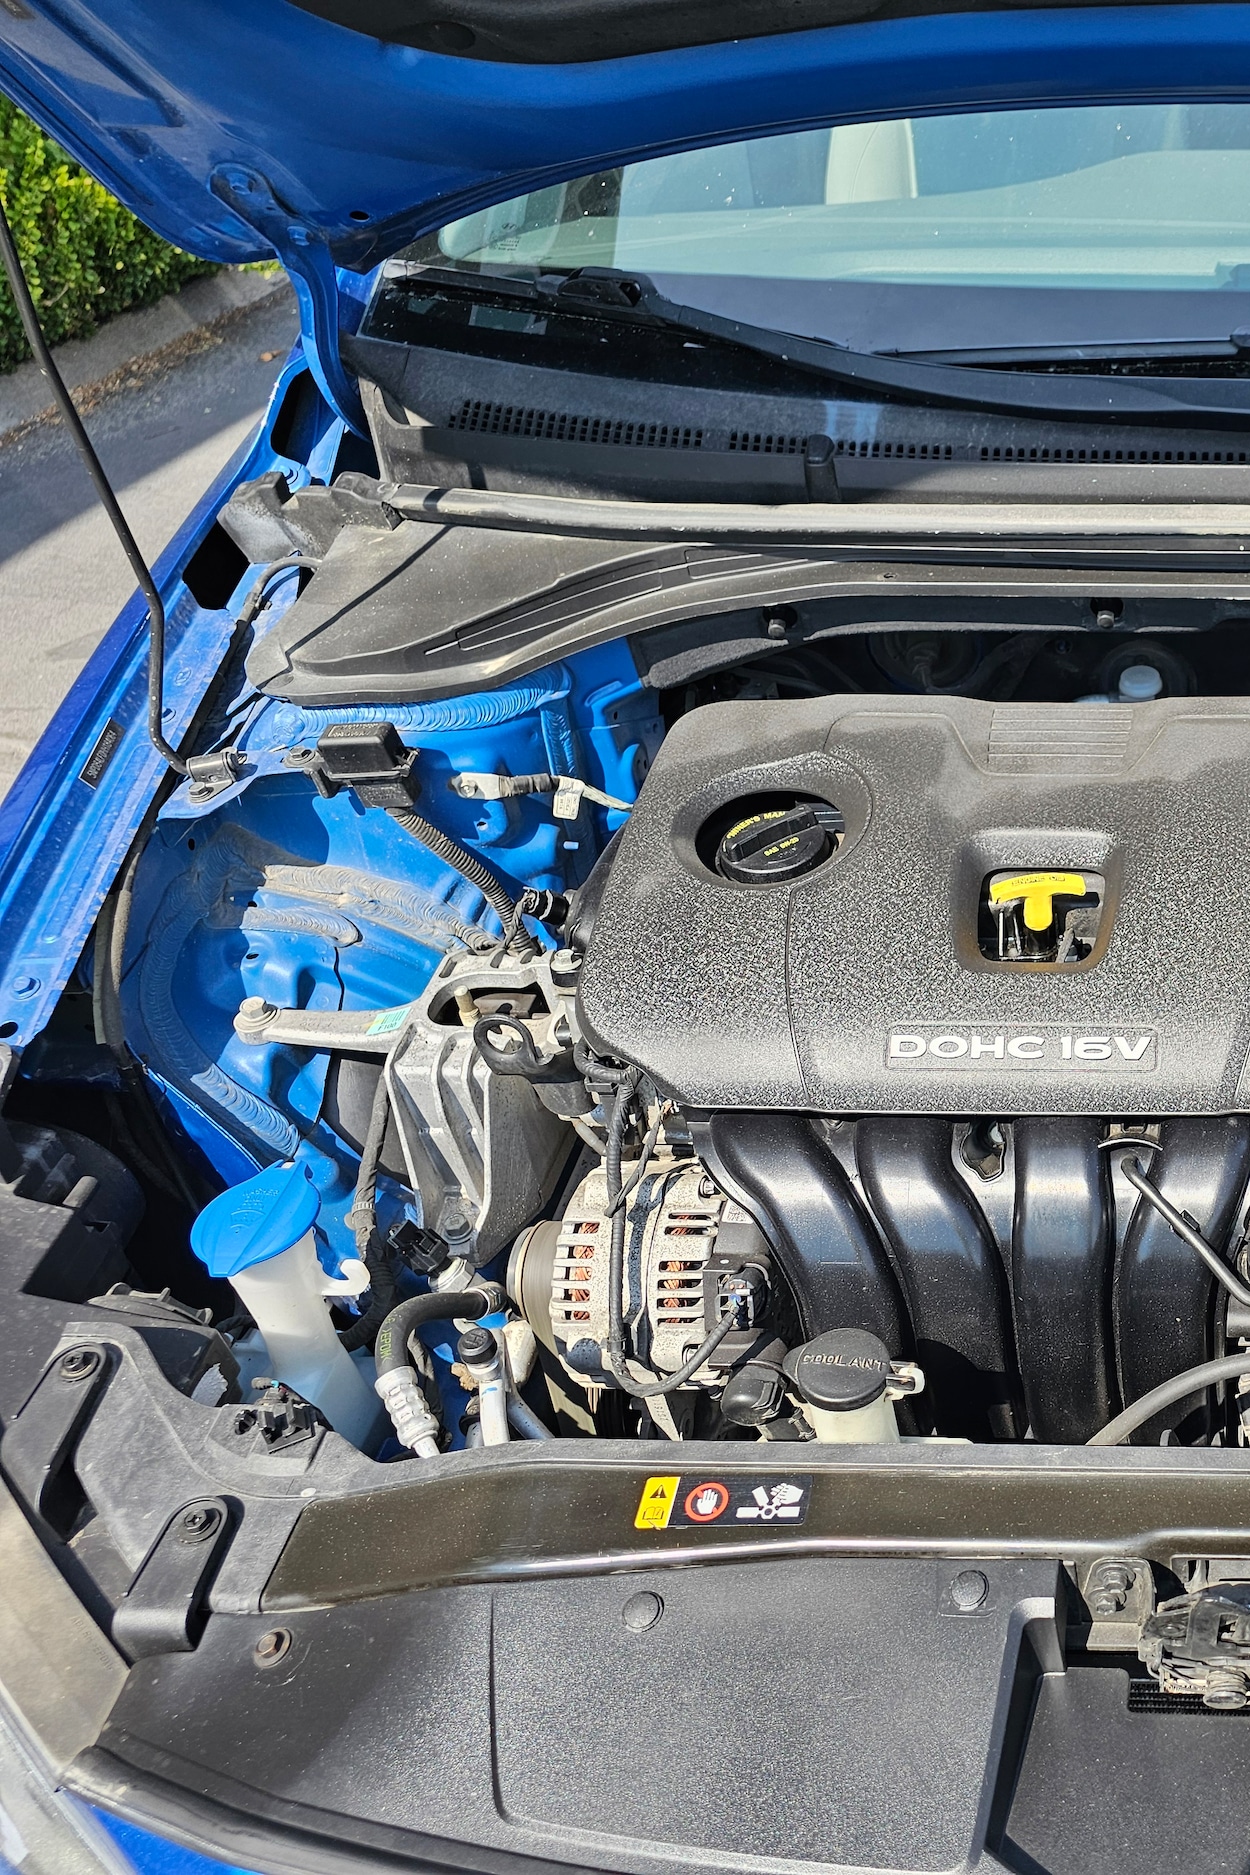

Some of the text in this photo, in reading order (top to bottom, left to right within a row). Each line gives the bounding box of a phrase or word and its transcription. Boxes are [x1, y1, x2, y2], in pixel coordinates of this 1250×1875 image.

[890, 1034, 1152, 1061] DOHC 16V
[803, 1354, 887, 1371] COOLANT
